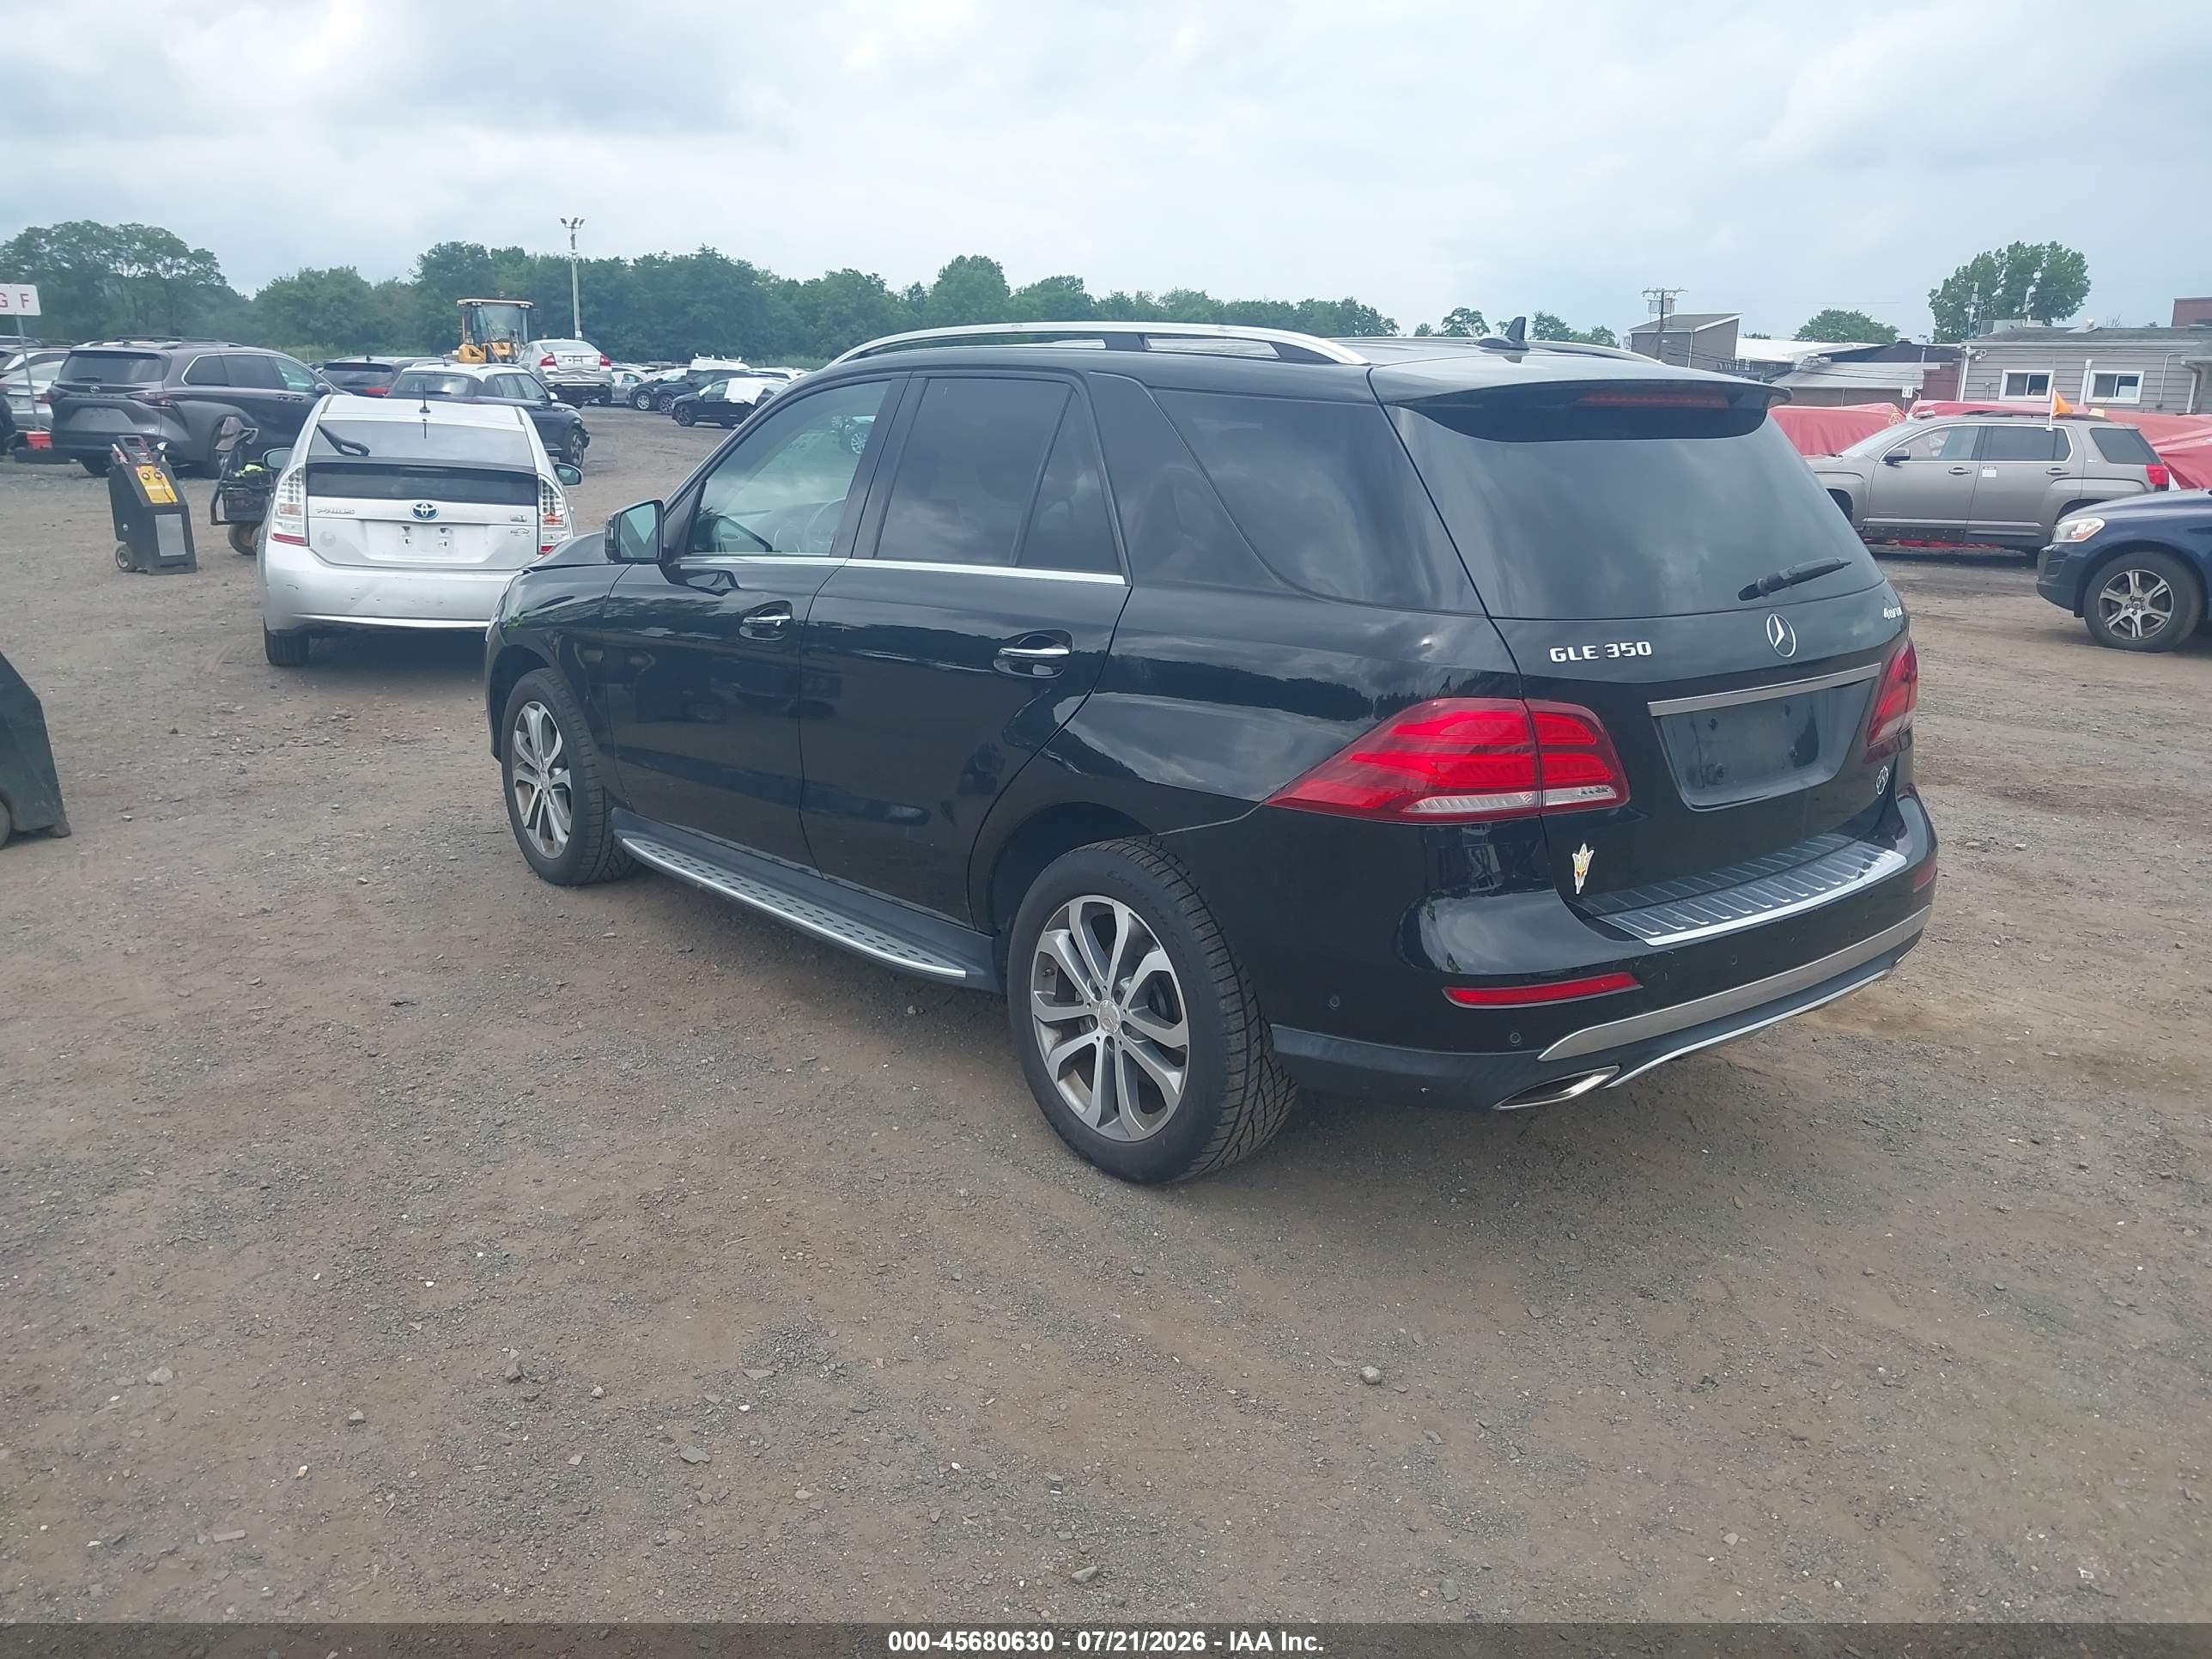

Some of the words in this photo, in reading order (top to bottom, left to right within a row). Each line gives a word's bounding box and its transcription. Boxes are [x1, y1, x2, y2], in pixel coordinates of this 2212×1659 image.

[20, 293, 29, 308] F
[1549, 646, 1600, 663] GLE
[1604, 641, 1653, 659] 350
